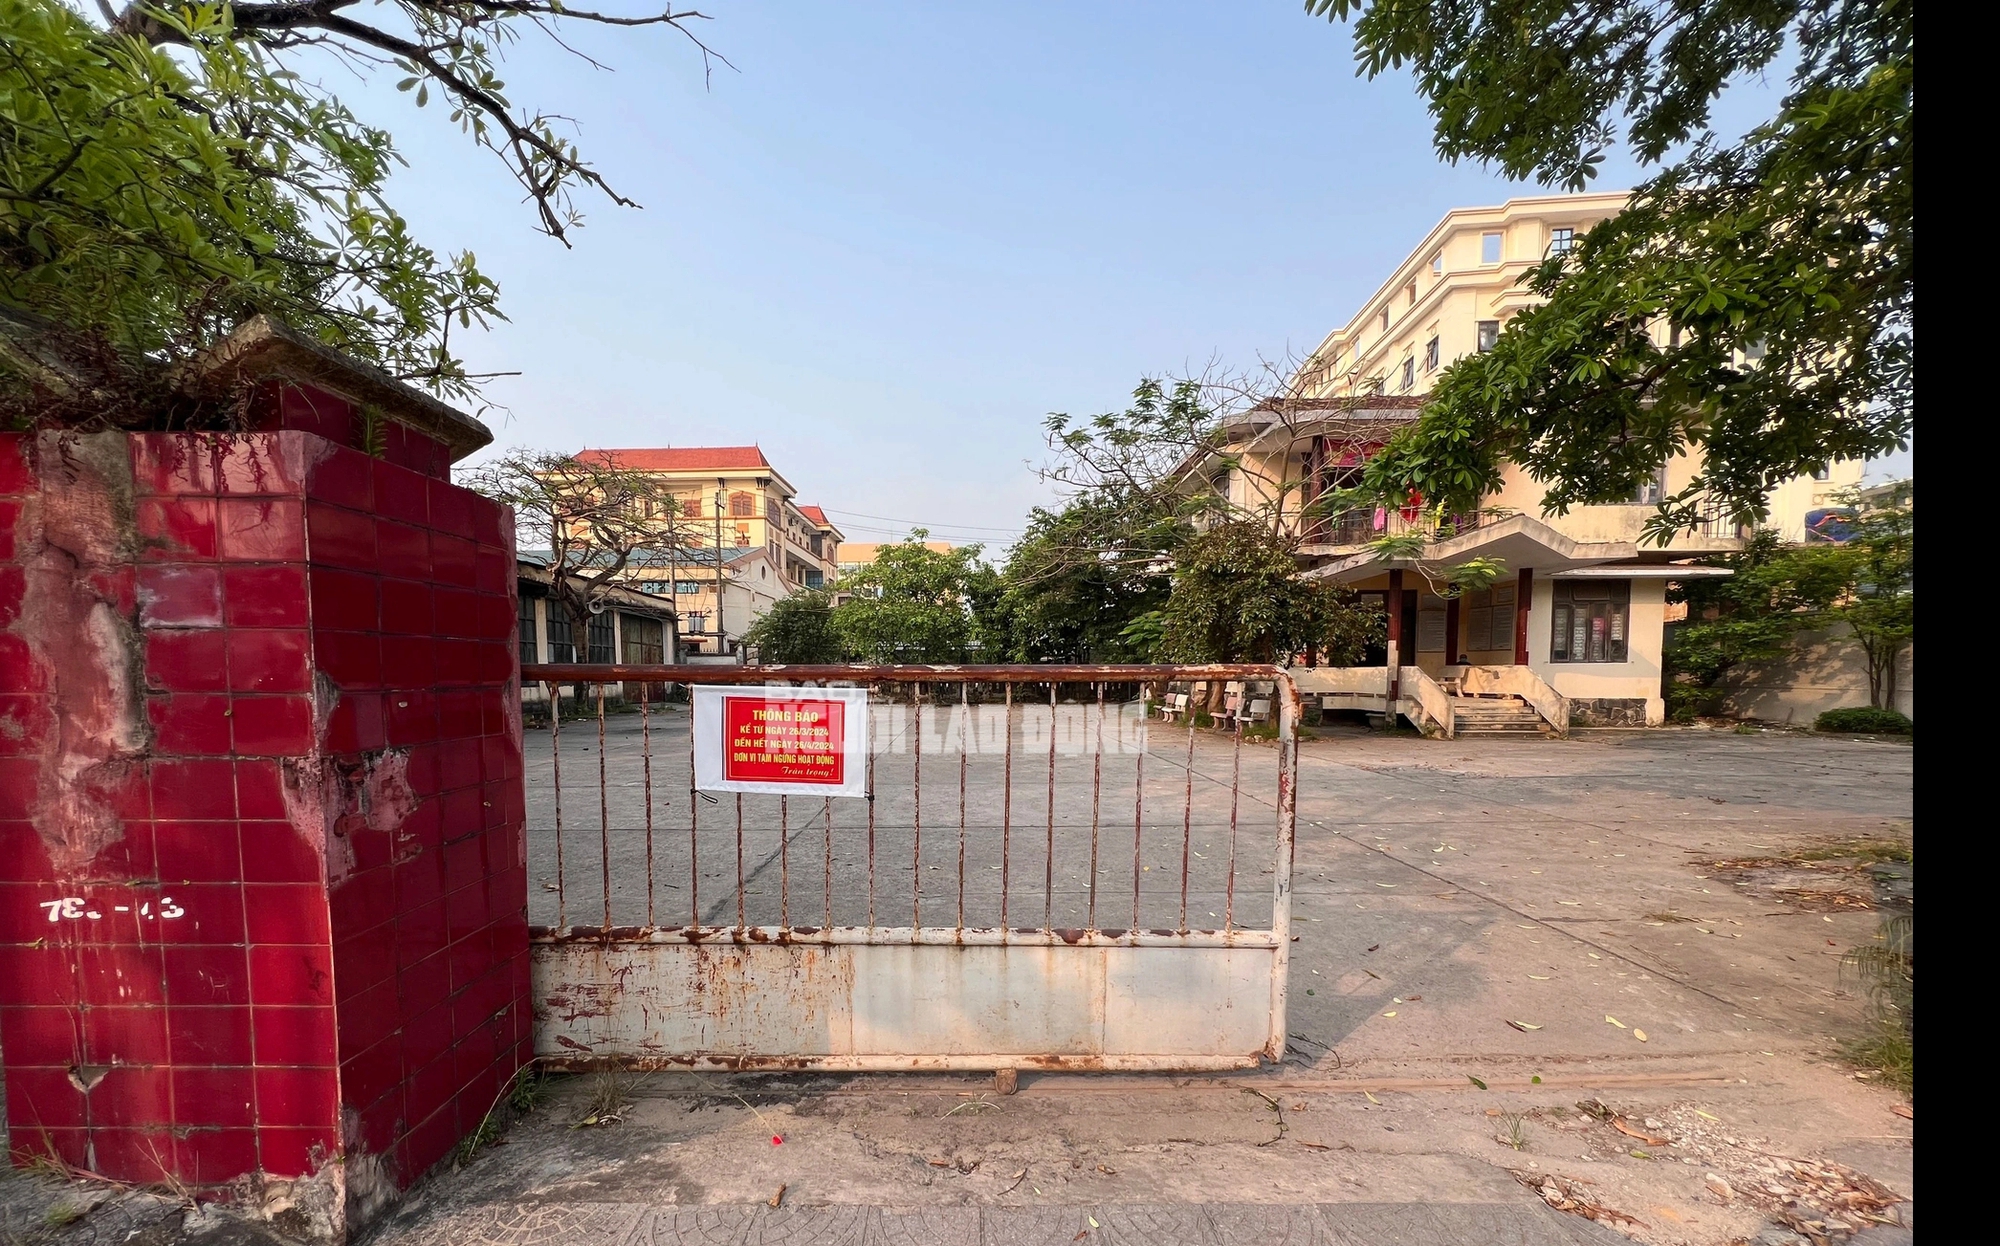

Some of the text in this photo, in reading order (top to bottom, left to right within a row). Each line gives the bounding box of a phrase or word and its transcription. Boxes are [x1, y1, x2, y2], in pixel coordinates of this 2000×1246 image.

[752, 708, 819, 723] THÔNG BÁO
[740, 722, 829, 737] KỂ TỪ NGÀY 26/3/2024
[734, 736, 834, 750] ĐẾN HẾT NGÀY 26/4/2024
[734, 752, 748, 762] ĐƠN
[749, 753, 756, 765] VỊ
[758, 754, 772, 765] TẠM
[797, 755, 814, 766] HOẠT
[816, 754, 835, 767] ĐỘNG
[806, 768, 834, 778] trọng!
